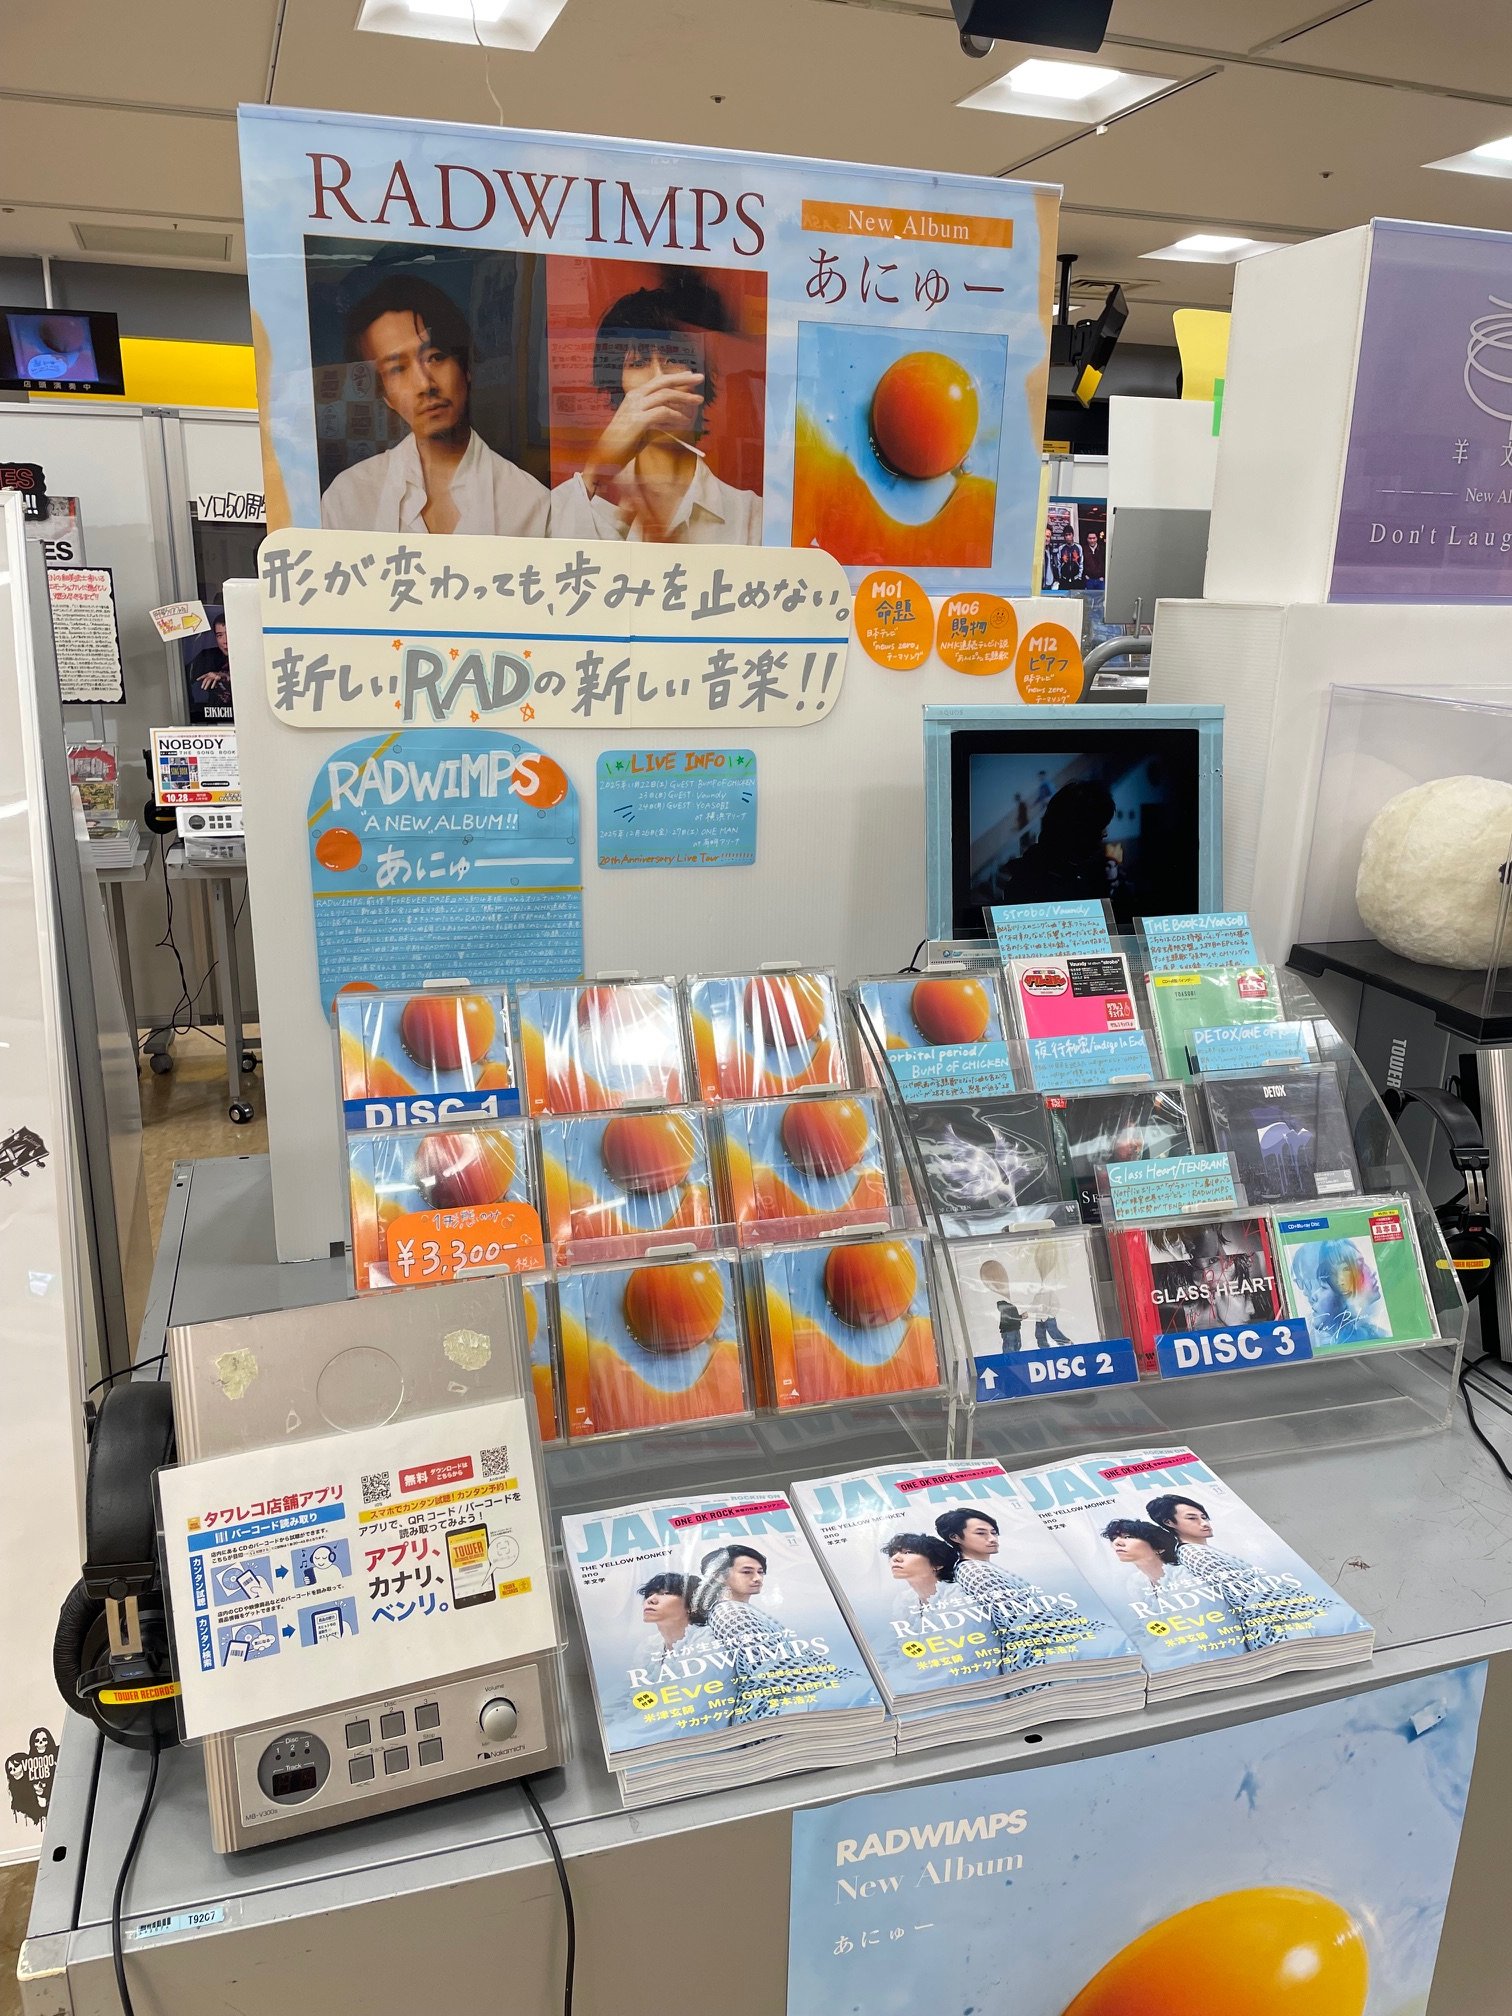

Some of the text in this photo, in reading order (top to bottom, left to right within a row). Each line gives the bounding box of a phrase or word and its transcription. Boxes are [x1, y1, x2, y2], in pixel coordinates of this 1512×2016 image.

[305, 152, 766, 257] RADWIMPS
[848, 209, 970, 240] New Album
[806, 248, 1004, 311] あにゅー
[1465, 487, 1494, 502] New
[1369, 523, 1437, 545] Don't
[875, 599, 916, 625] 命題
[866, 627, 898, 638] 日本テレビ
[951, 617, 987, 638] 賜物
[1029, 636, 1058, 652] M12
[886, 651, 924, 661] テーマソング
[1029, 653, 1069, 672] ピアフ
[204, 706, 232, 718] EIKICHI
[159, 738, 224, 750] NOBODY
[631, 752, 726, 773] LIVE INFO
[327, 750, 542, 811] RADWIMPS
[166, 794, 189, 803] 10.28
[599, 855, 621, 866] 20th
[677, 853, 698, 863] Live
[1145, 918, 1171, 934] THE
[888, 1048, 935, 1063] orbital
[961, 1058, 1010, 1071] CHICKEN
[1386, 1039, 1407, 1088] TOWER
[1262, 1084, 1287, 1099] DETOX
[1109, 1166, 1143, 1184] Glass
[1151, 1275, 1275, 1305] GLASS HEART
[1173, 1325, 1295, 1369] DISC 3
[1028, 1352, 1114, 1383] DISC 2
[403, 1470, 428, 1487] 無料
[430, 1462, 468, 1477] ダウンロードは
[436, 1469, 464, 1481] こちらから
[1104, 1462, 1154, 1479] ONE OK ROCK
[900, 1480, 919, 1491] ONE
[919, 1476, 933, 1487] OK
[933, 1474, 956, 1485] ROCK
[204, 1484, 344, 1528] タワレコ店舗アプリ
[1054, 1498, 1117, 1516] YELLOW MONKEY
[231, 1512, 318, 1541] バーコード読み取り
[674, 1517, 694, 1528] ONE
[695, 1512, 709, 1523] OK
[710, 1508, 735, 1520] ROCK
[577, 1502, 796, 1562] JAPAN
[821, 1525, 837, 1533] THE
[823, 1532, 840, 1540] ano
[364, 1537, 441, 1572] アプリ、
[453, 1541, 484, 1559] TOWER
[580, 1549, 674, 1572] THE YELLOW MONKEY
[191, 1557, 207, 1608] カンタン試聴
[368, 1565, 445, 1600] カナリ、
[1128, 1572, 1303, 1620] RADWIMPS
[371, 1592, 449, 1623] ベンリ。
[890, 1592, 1079, 1639] RADWIMPS
[1167, 1610, 1226, 1632] Eve
[1217, 1609, 1328, 1636] Mrs. GREEN APPLE
[198, 1618, 214, 1668] カンタン検索
[925, 1631, 988, 1654] Eve
[974, 1645, 1004, 1660] Mrs.
[1005, 1636, 1051, 1651] GREEN
[1054, 1630, 1098, 1645] APPLE
[626, 1636, 830, 1689] RADWIMPS
[949, 1653, 1020, 1677] サカナクション
[113, 1685, 175, 1702] TOWER RECORDS
[484, 1683, 505, 1692] Volume
[659, 1679, 725, 1706] Eve
[643, 1679, 842, 1724] 米津玄師 Mrs. GREEN APPLE
[675, 1704, 753, 1730] サカナクション
[285, 1736, 299, 1744] Disc
[490, 1744, 526, 1758] Nakamichi
[21, 1754, 54, 1772] VOODOO
[285, 1763, 303, 1771] Track
[29, 1767, 51, 1781] CLUB
[836, 1808, 1028, 1867] RADWIMPS
[834, 1854, 1025, 1906] New Album
[833, 1923, 935, 1956] あにゅー
